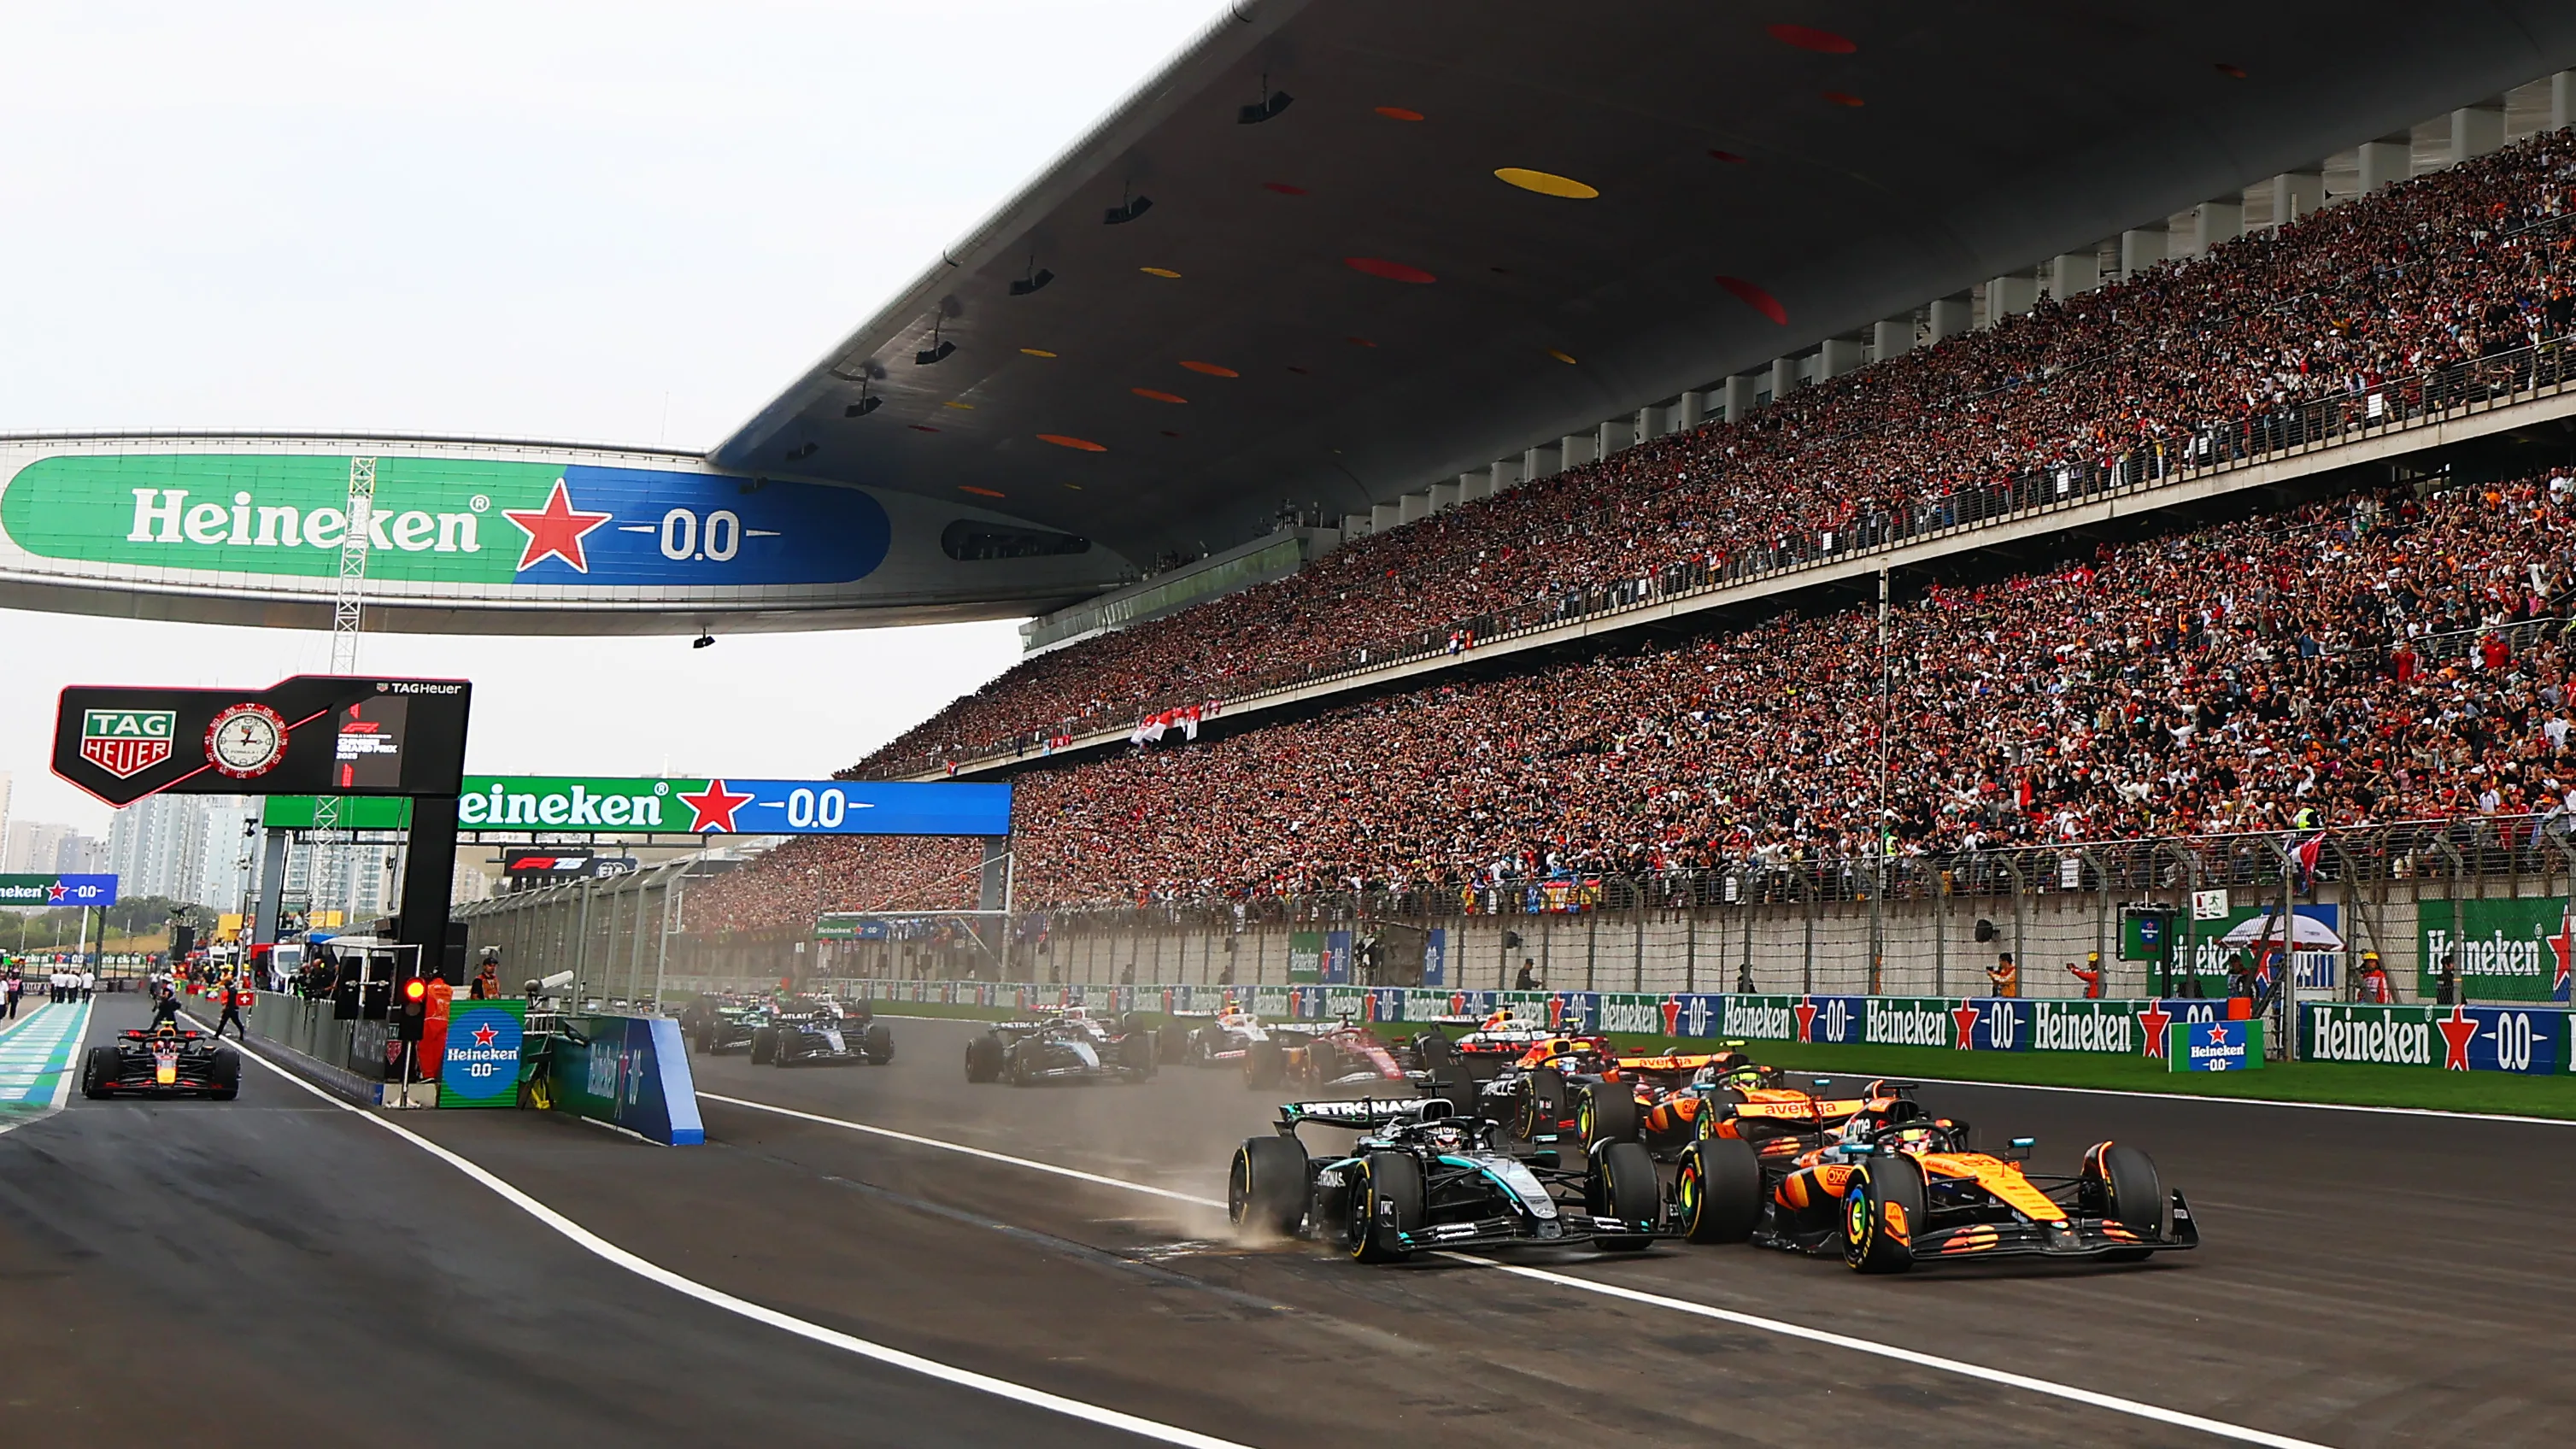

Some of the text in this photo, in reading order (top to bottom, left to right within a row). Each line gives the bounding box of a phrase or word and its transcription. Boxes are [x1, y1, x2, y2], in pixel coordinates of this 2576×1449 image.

[127, 488, 739, 561] Heineken 0.0
[92, 714, 167, 736] TAG
[86, 741, 167, 773] HEUER
[458, 783, 845, 828] eineken 0.0
[0, 884, 97, 898] neken 0.0
[2427, 930, 2541, 976] Hineken
[1599, 994, 1706, 1036] Heineken 0.0
[1722, 995, 1846, 1042] Heineken 0.0
[1865, 1000, 2015, 1049] Heineken 0.0
[2034, 1002, 2133, 1053] Heineken
[447, 1047, 518, 1061] Heineken
[2191, 1044, 2244, 1059] Heineken
[2313, 1007, 2432, 1065] Heineken
[2497, 1012, 2532, 1071] 0.0
[472, 1063, 492, 1077] 0.0
[2209, 1059, 2227, 1071] 0.0
[1482, 1079, 1517, 1096] ORACLE
[1302, 1100, 1412, 1116] PETRONAS
